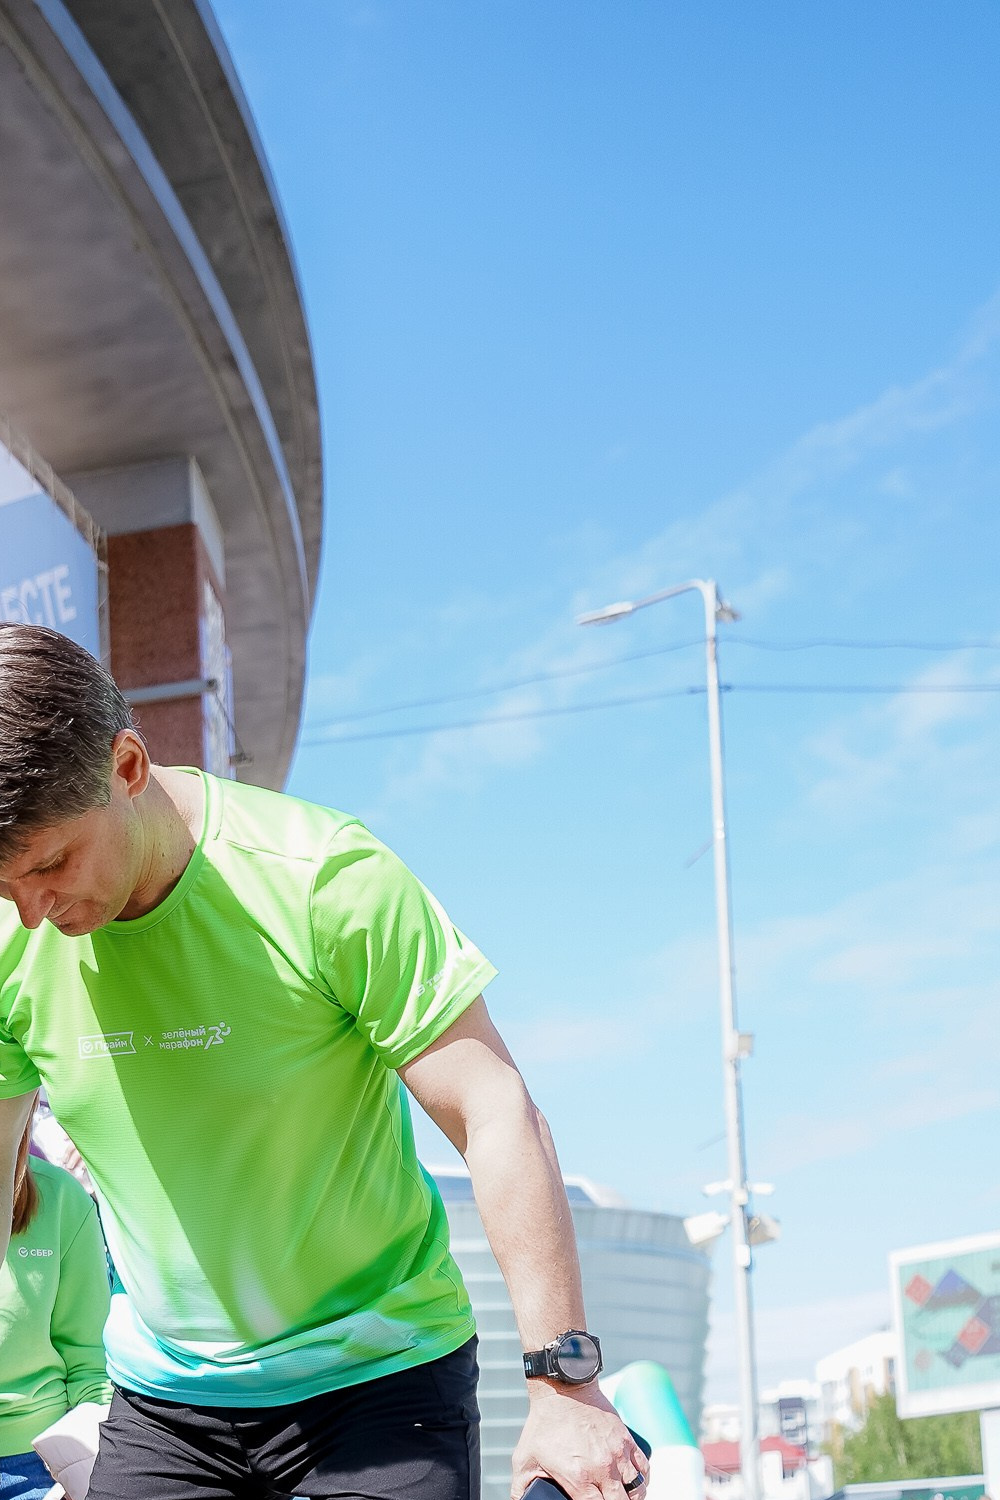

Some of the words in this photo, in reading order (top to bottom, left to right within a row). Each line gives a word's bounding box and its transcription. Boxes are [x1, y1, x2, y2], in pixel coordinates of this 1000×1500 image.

[161, 1025, 206, 1040] зелёный
[94, 1038, 128, 1051] Прайм
[159, 1037, 204, 1051] марафон
[30, 1249, 54, 1257] СБЕР
